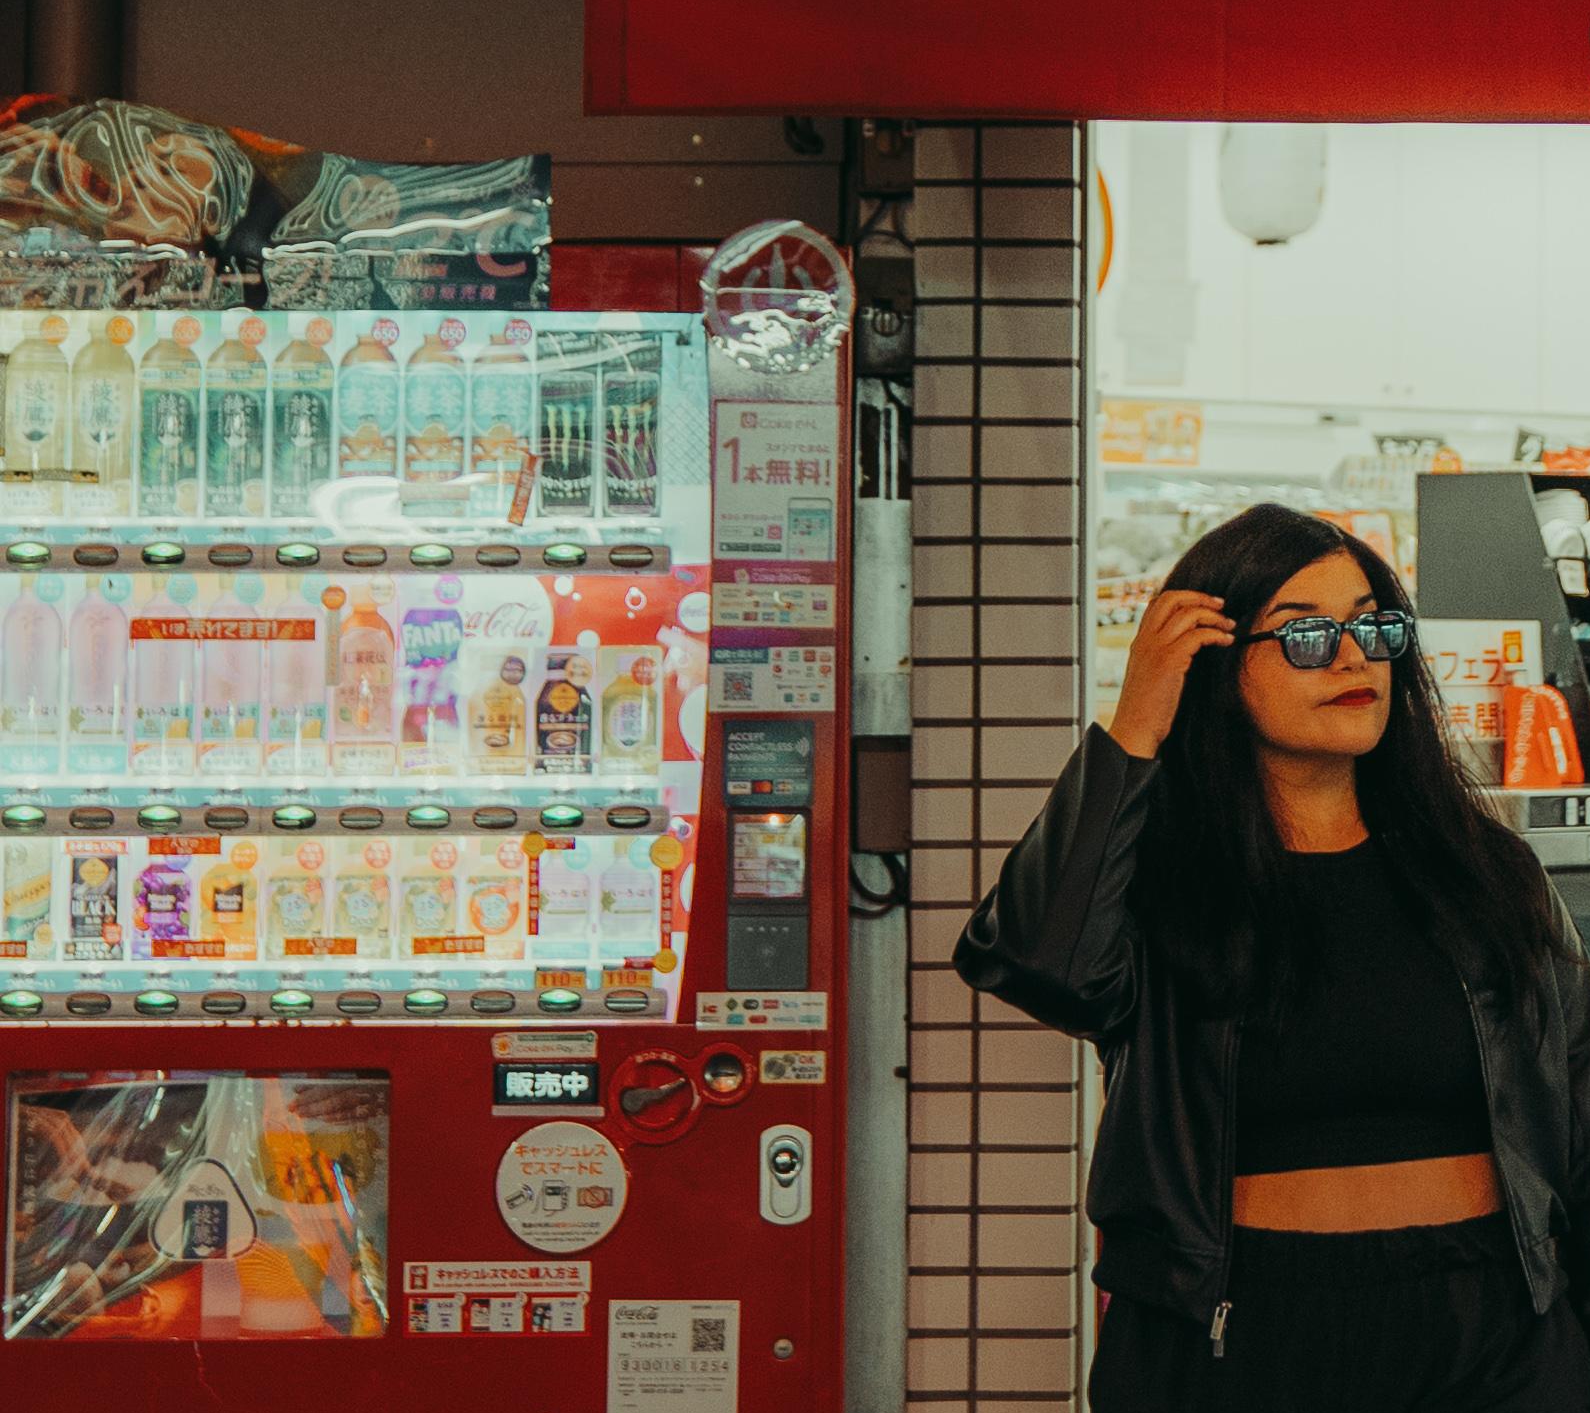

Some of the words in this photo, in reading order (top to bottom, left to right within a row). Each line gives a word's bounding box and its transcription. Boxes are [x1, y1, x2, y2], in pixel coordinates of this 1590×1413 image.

[505, 1071, 589, 1098] 販売中
[514, 1144, 608, 1158] キャッシュレス
[521, 1162, 603, 1175] でスマートに
